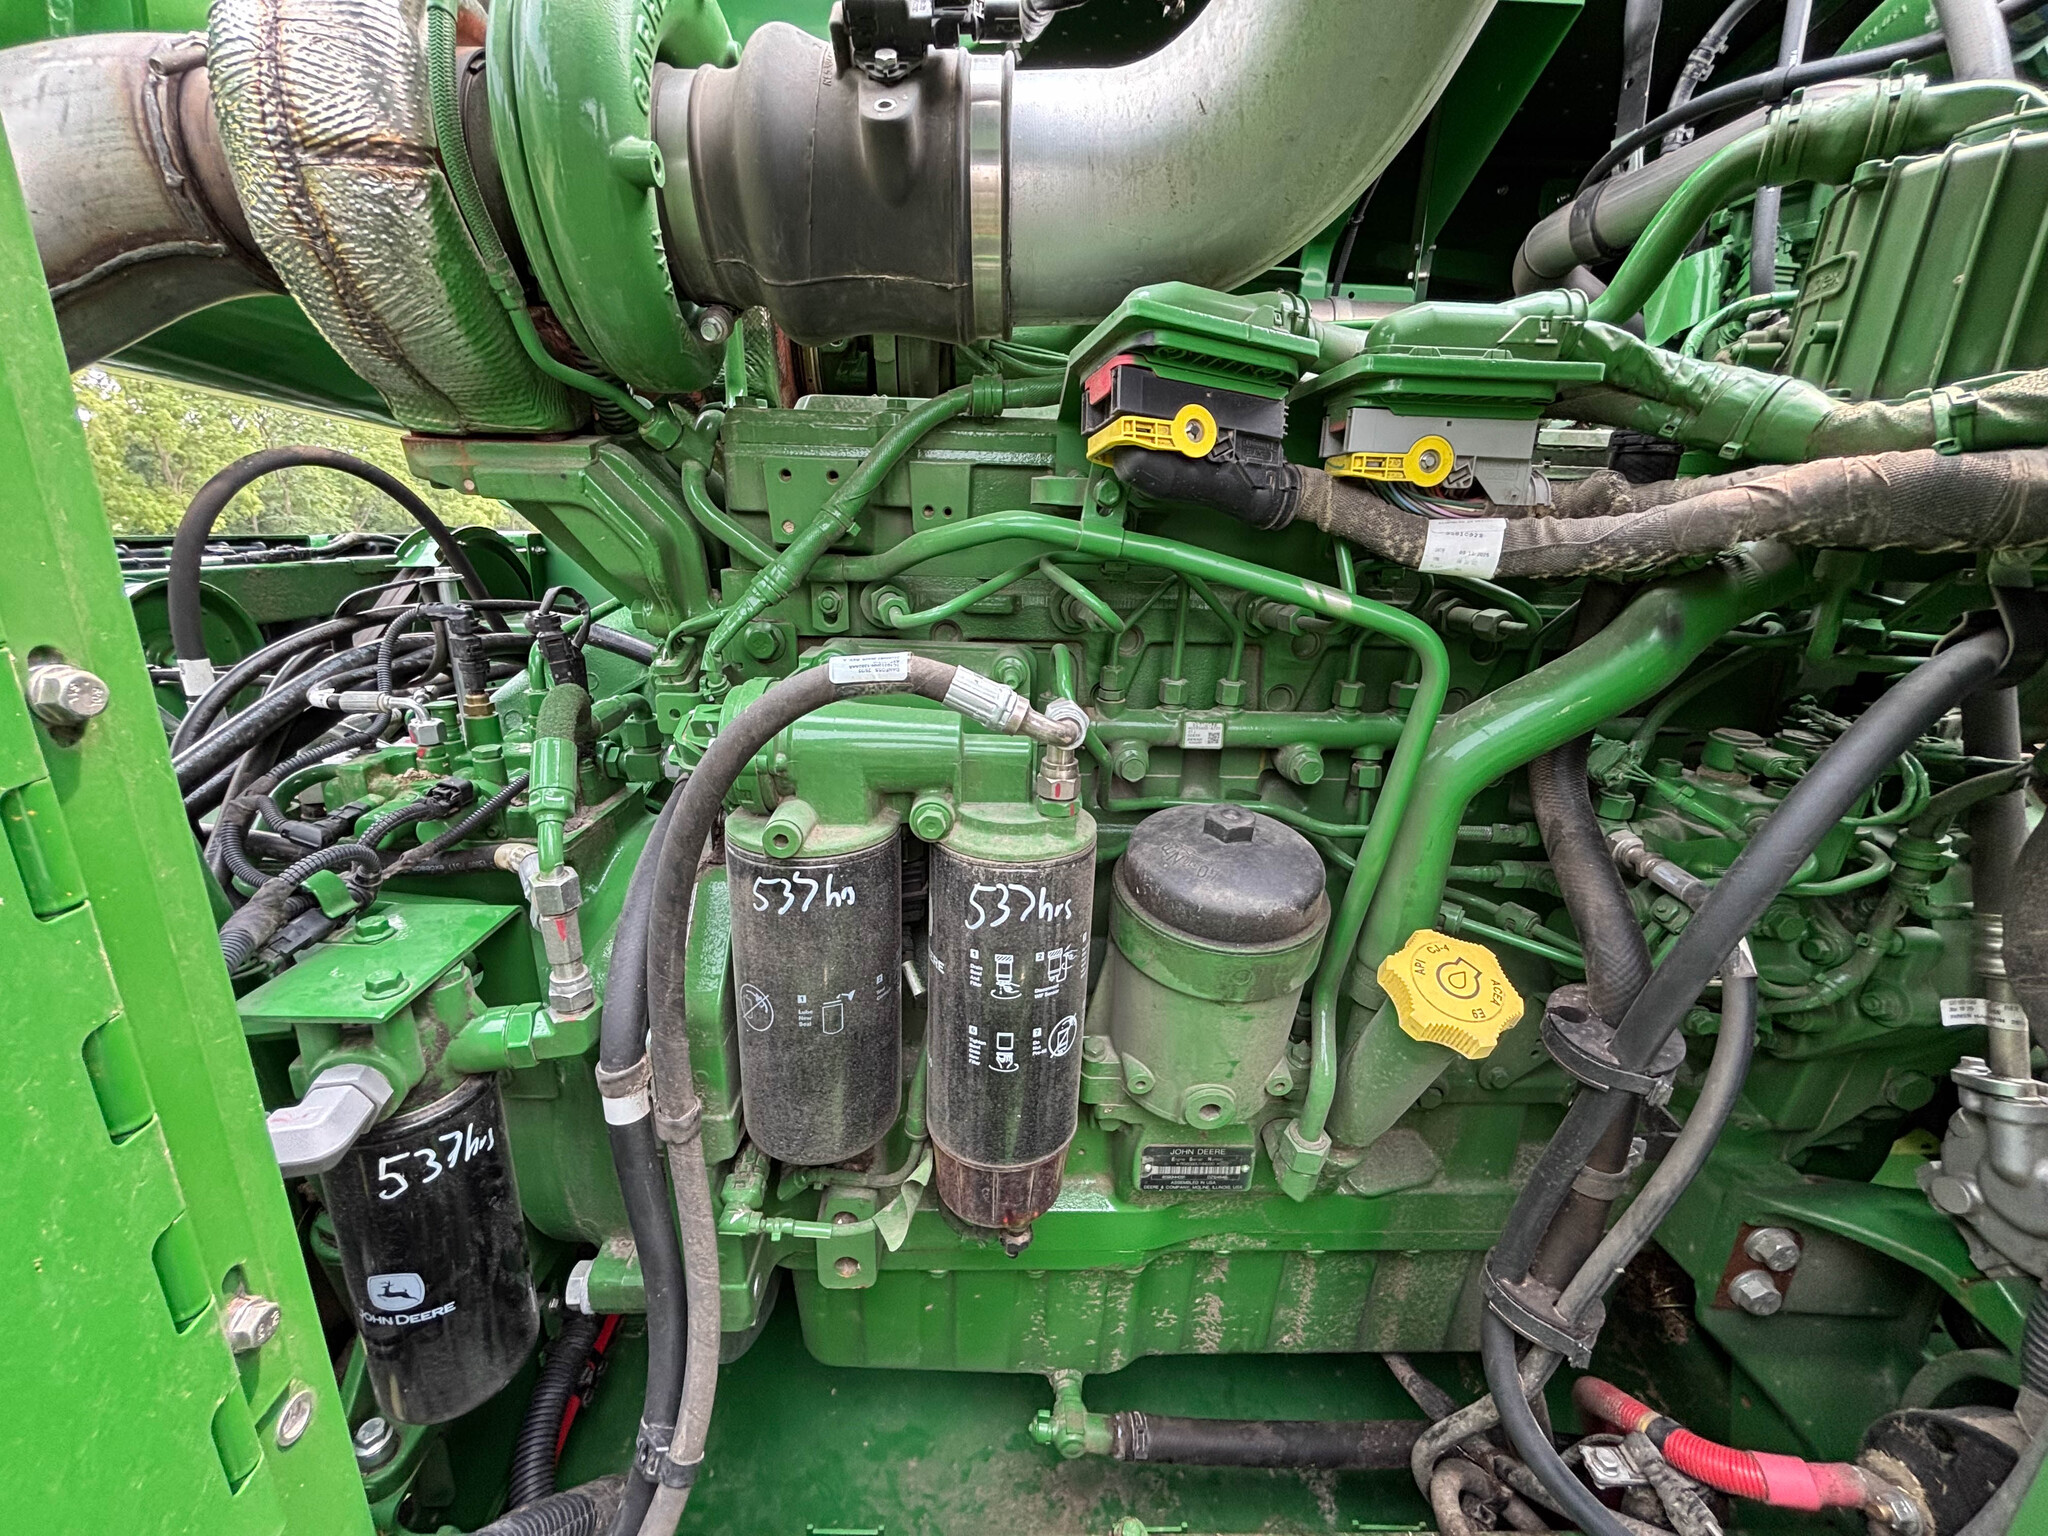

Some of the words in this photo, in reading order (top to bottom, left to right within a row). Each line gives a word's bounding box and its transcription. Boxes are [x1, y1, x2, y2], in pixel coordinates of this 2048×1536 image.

[1414, 958, 1426, 976] API
[1426, 944, 1450, 954] CJ-4
[1490, 979, 1503, 1006] ACEA
[395, 1301, 456, 1326] DEERE
